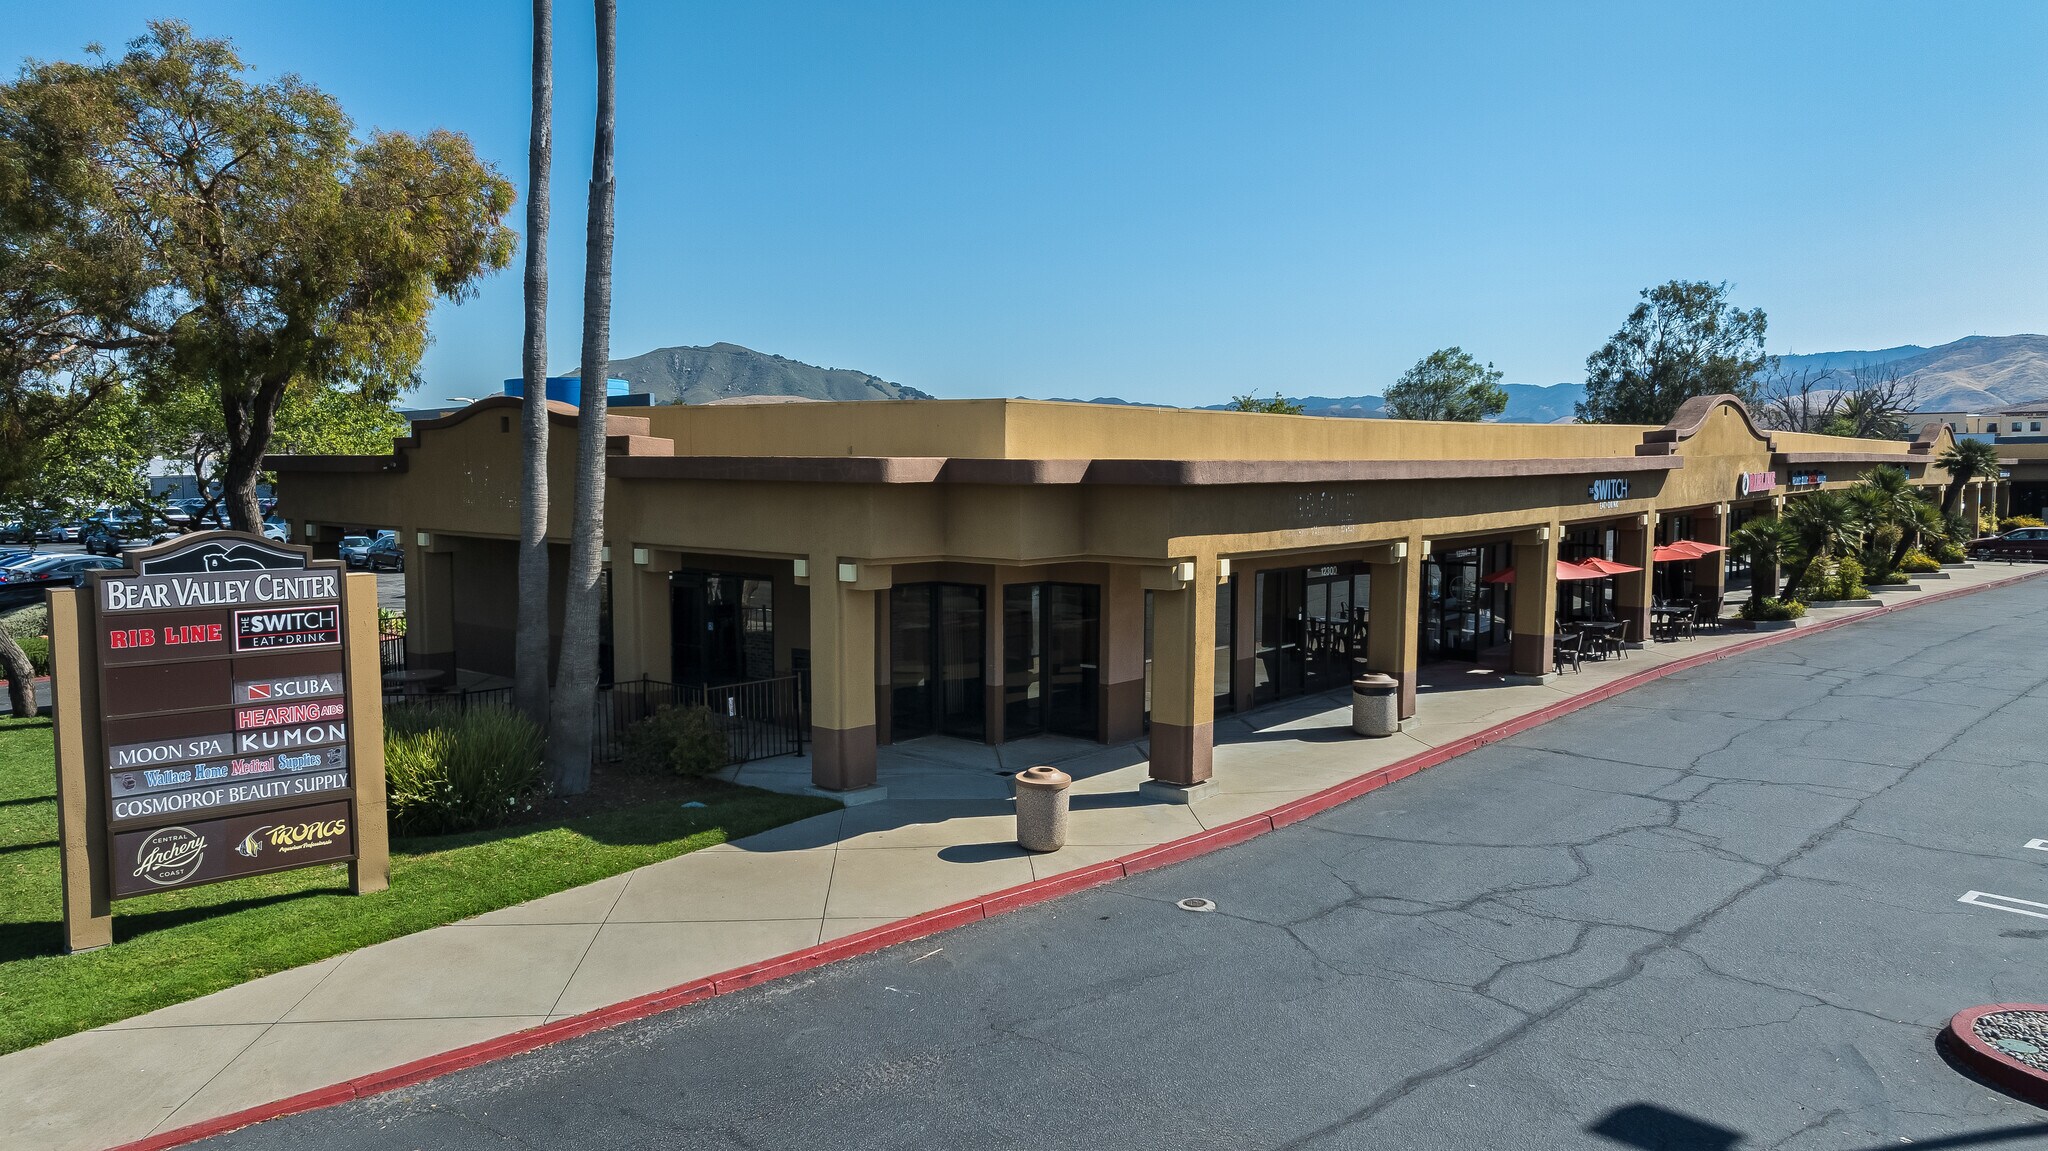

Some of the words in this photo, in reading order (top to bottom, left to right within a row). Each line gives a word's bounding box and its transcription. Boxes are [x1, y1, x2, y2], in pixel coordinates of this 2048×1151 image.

[1593, 478, 1628, 501] SWITCH
[107, 581, 170, 610] BEAR
[172, 578, 251, 605] VALLEY
[254, 574, 337, 601] CENTER
[241, 617, 250, 634] THE
[251, 611, 334, 632] SWITCH
[110, 628, 156, 649] RIB
[164, 624, 222, 645] LINE
[253, 636, 276, 647] EAT
[286, 633, 326, 644] DRINK
[274, 679, 333, 697] SCUBA
[239, 704, 320, 728] HEARING
[321, 704, 344, 717] AIDS
[242, 724, 345, 751] KUMON
[118, 744, 182, 765] MOON
[188, 740, 222, 757] SPA
[144, 769, 192, 787] Wallace
[195, 763, 228, 781] Home
[231, 757, 275, 776] Medical
[278, 754, 322, 771] Supplies
[115, 790, 224, 818] COSMOPROF
[230, 777, 292, 803] BEAUTY
[294, 773, 348, 794] SUPPLY
[152, 834, 188, 844] CENTRAL
[265, 819, 346, 846] TROPICS
[133, 836, 208, 877] Archery
[159, 868, 185, 878] COAST
